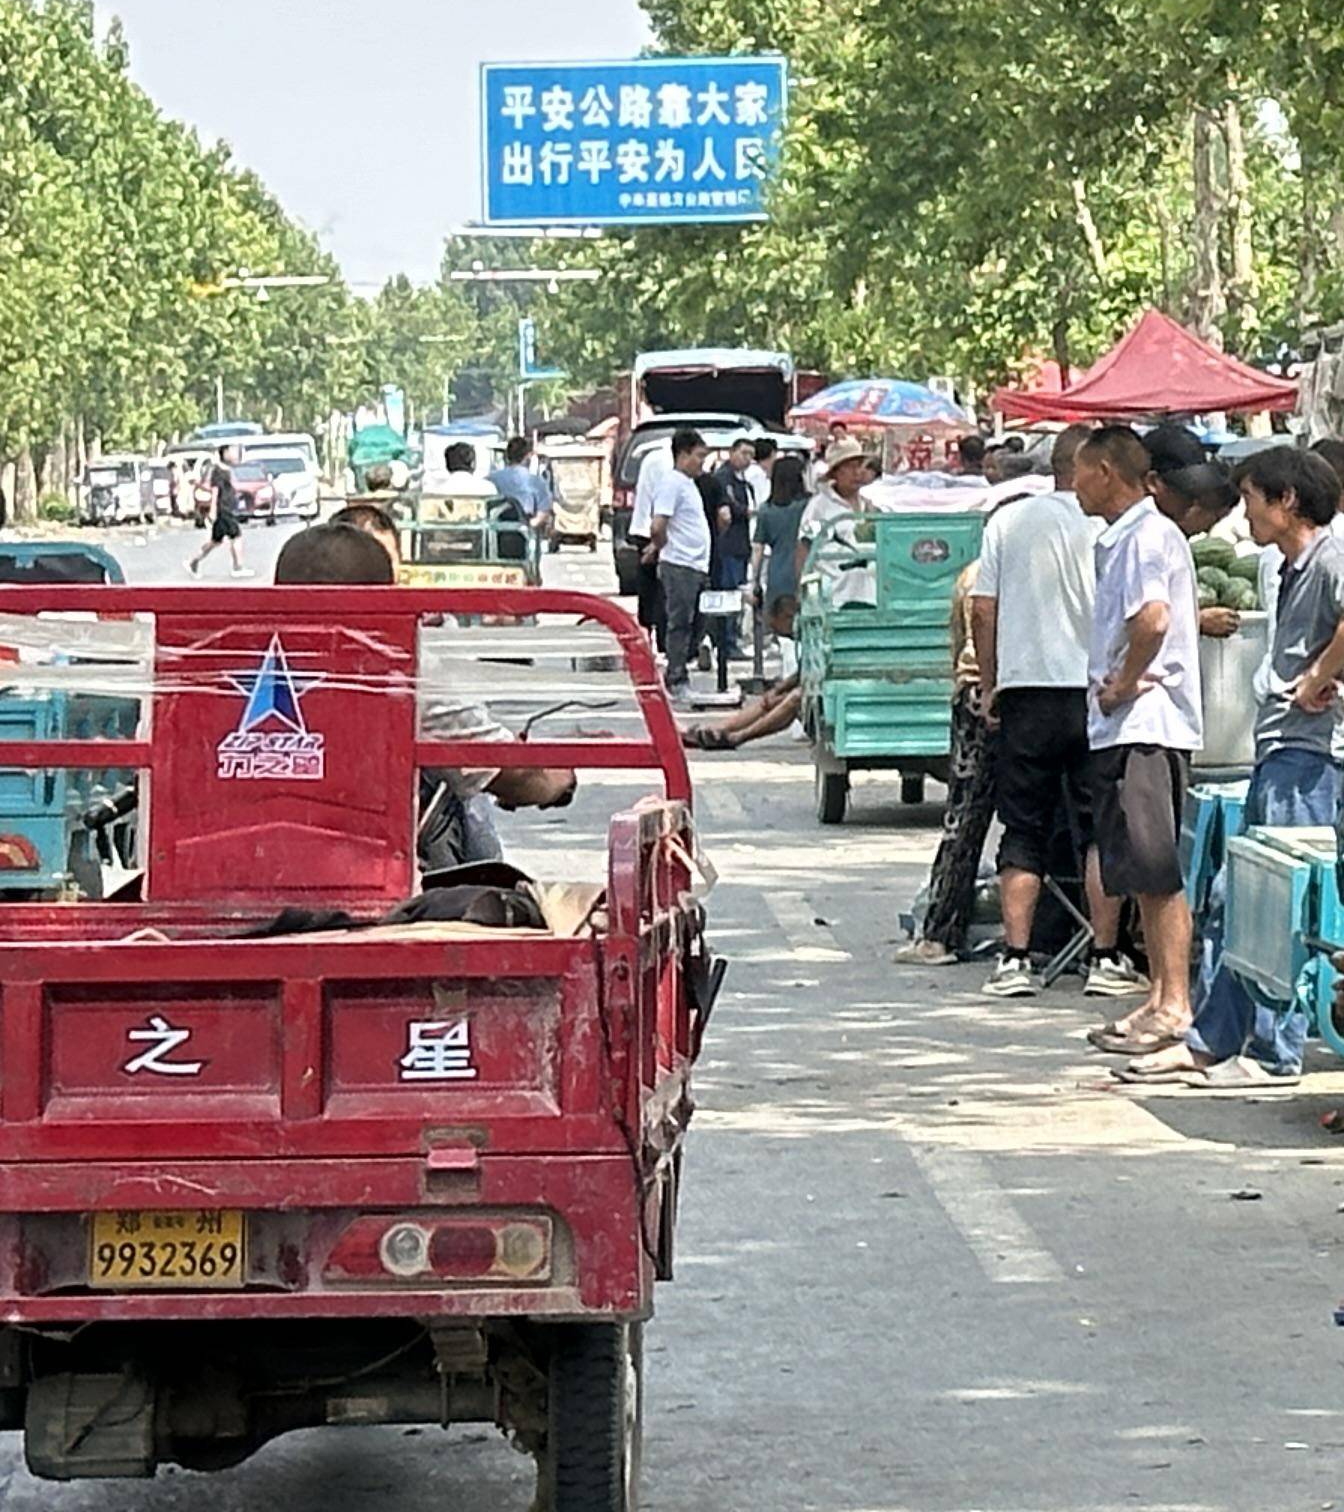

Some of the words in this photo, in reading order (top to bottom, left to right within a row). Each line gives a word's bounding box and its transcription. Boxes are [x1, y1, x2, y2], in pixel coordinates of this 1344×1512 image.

[501, 81, 768, 131] 平安公路靠大家
[500, 136, 767, 185] 出行平安为人民
[124, 1016, 203, 1074] 之
[401, 1018, 476, 1080] 星
[98, 1242, 237, 1277] 9932369
